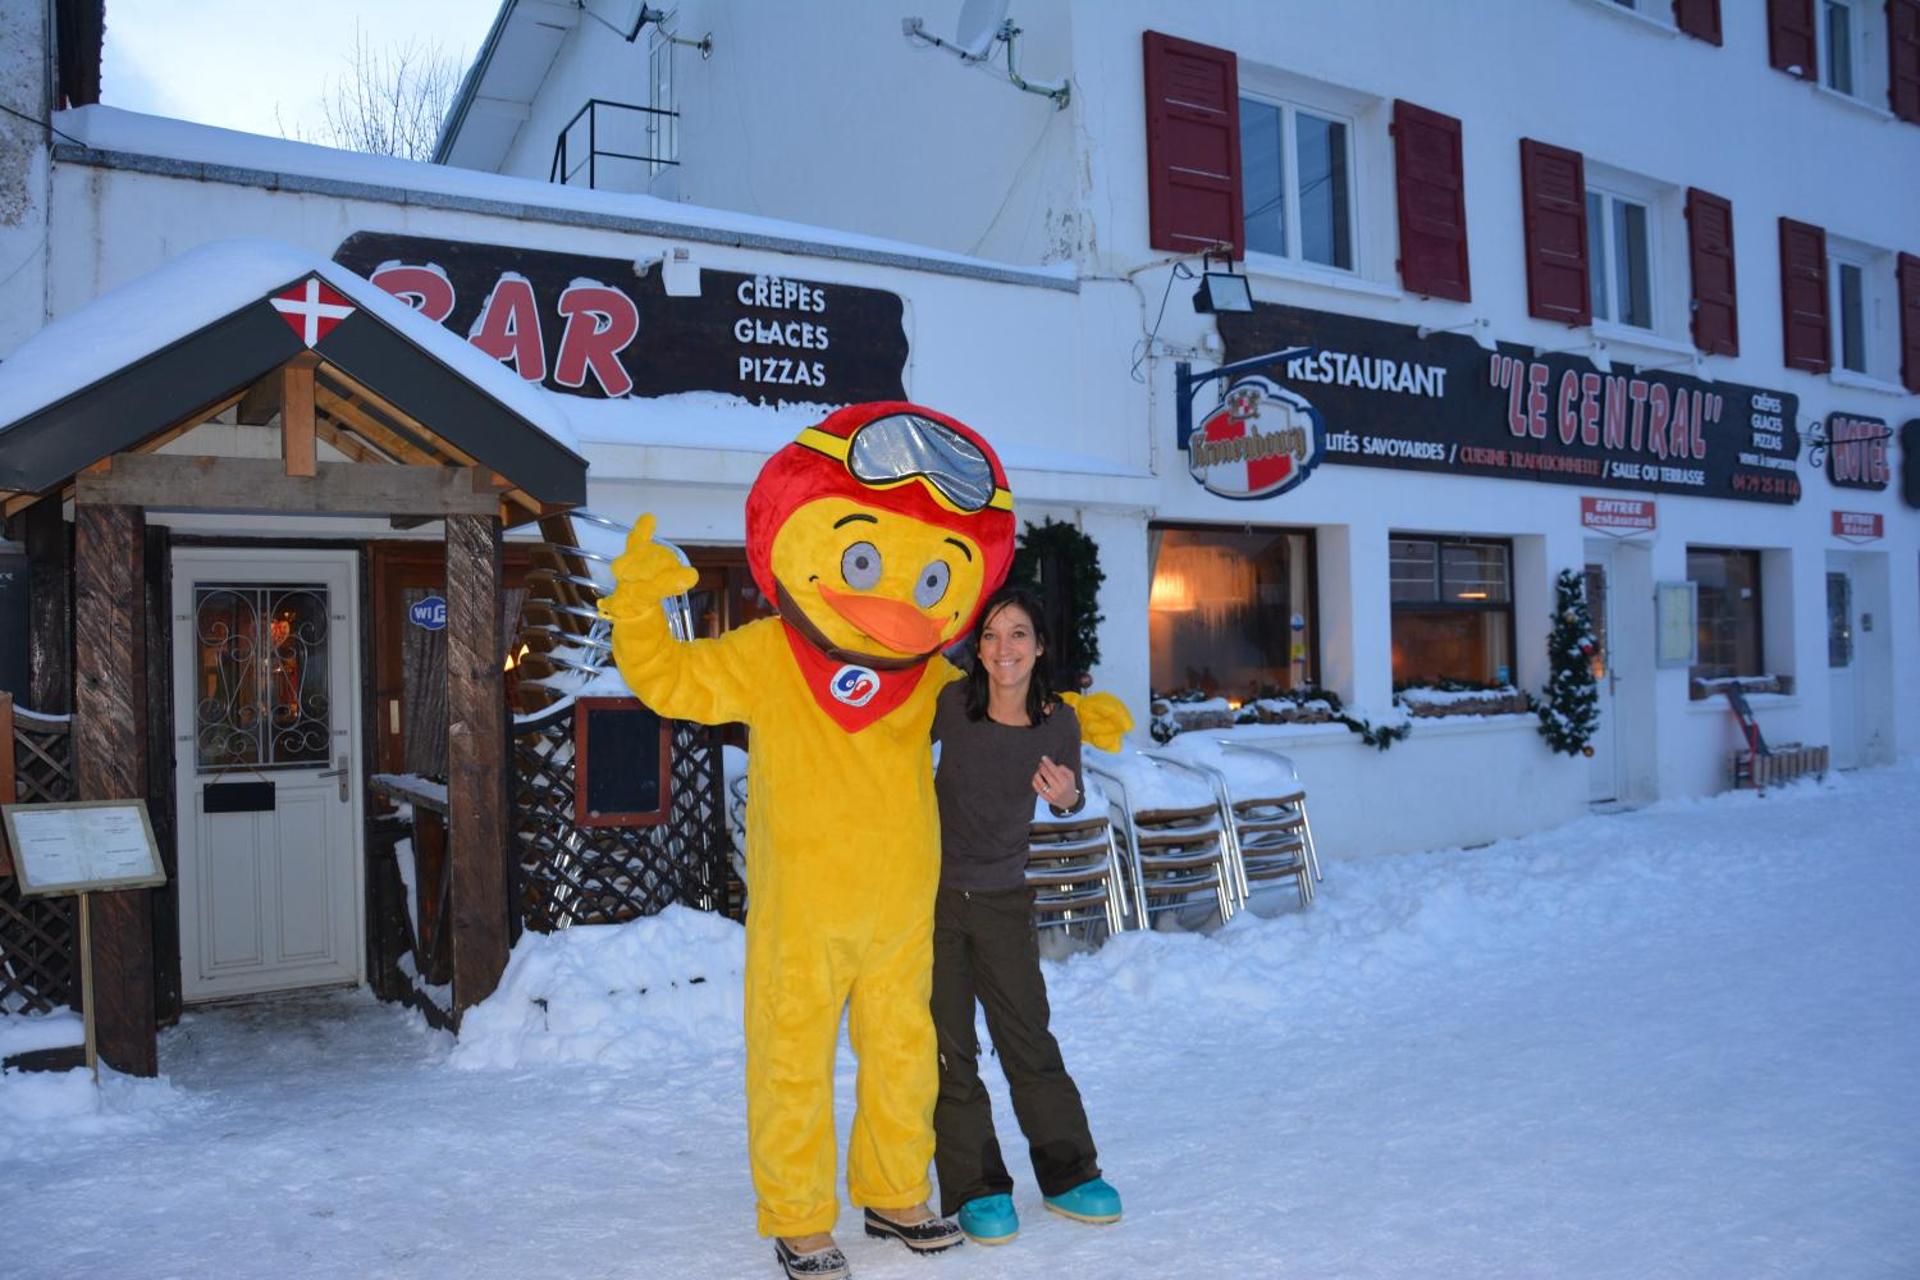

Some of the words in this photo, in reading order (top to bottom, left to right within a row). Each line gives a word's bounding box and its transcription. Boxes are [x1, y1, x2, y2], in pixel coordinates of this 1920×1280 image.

[734, 317, 829, 350] GLACES
[739, 356, 826, 387] PIZZAS
[1287, 349, 1447, 398] RESTAURANT
[1558, 369, 1723, 460] CENTRAL"
[1751, 414, 1783, 432] GLACES
[1325, 430, 1359, 453] LITÉS
[1362, 436, 1446, 460] SAVOYARDES
[1611, 462, 1640, 479] SALLE
[1641, 464, 1659, 481] OU
[1660, 466, 1705, 485] TERRASSE
[1753, 432, 1782, 451] PIZZAS
[1585, 511, 1653, 527] Restaurant
